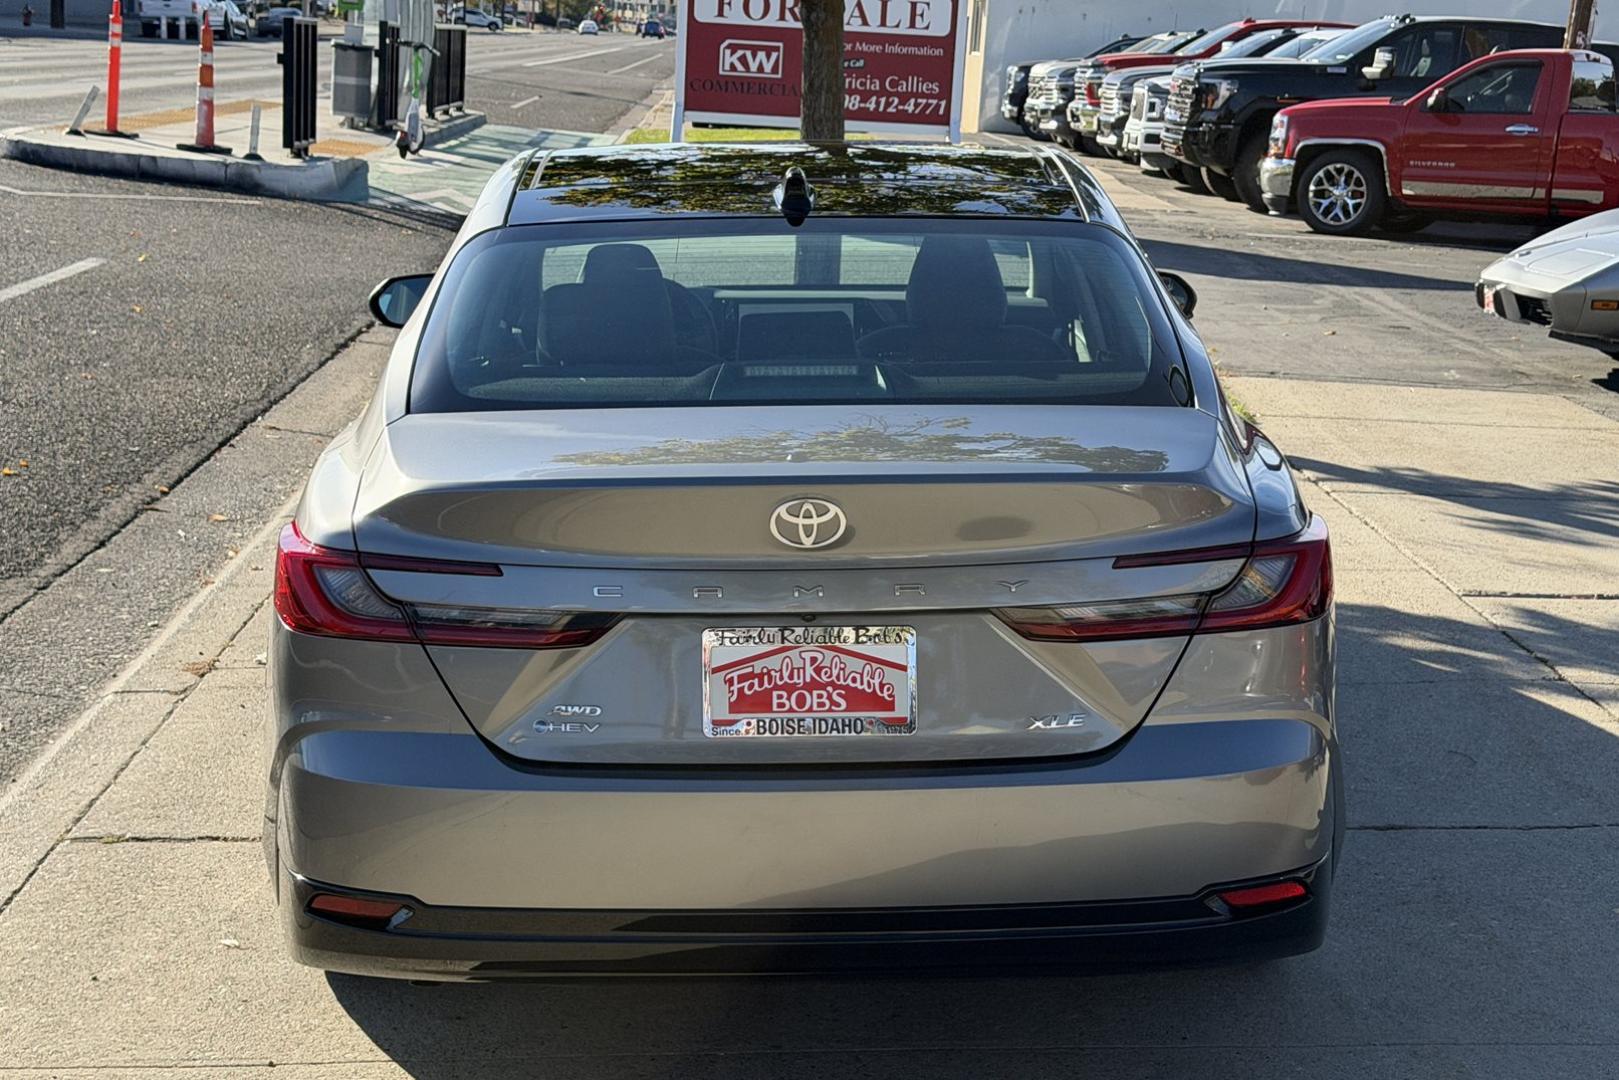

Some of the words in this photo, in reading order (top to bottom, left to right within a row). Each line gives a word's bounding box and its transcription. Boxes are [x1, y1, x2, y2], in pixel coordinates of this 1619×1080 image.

[714, 0, 801, 22] FOR
[845, 0, 931, 30] ALE
[855, 42, 883, 53] More
[885, 43, 944, 56] Information
[724, 48, 779, 73] KW
[690, 79, 799, 96] COMMERCIA
[843, 72, 880, 91] ricia
[885, 75, 940, 94] Callies
[843, 94, 947, 115] 8-412-4771
[592, 579, 1029, 599] CAMRY
[715, 626, 776, 647] Fairly
[779, 626, 850, 646] Reliable
[724, 655, 804, 702] Fairly
[799, 650, 896, 701] Reliable
[772, 685, 847, 712] BOB'S
[548, 704, 602, 716] AWD
[548, 722, 600, 733] HEV
[756, 718, 806, 735] BOISE
[812, 718, 864, 735] IDAHO
[1026, 712, 1086, 730] XLE
